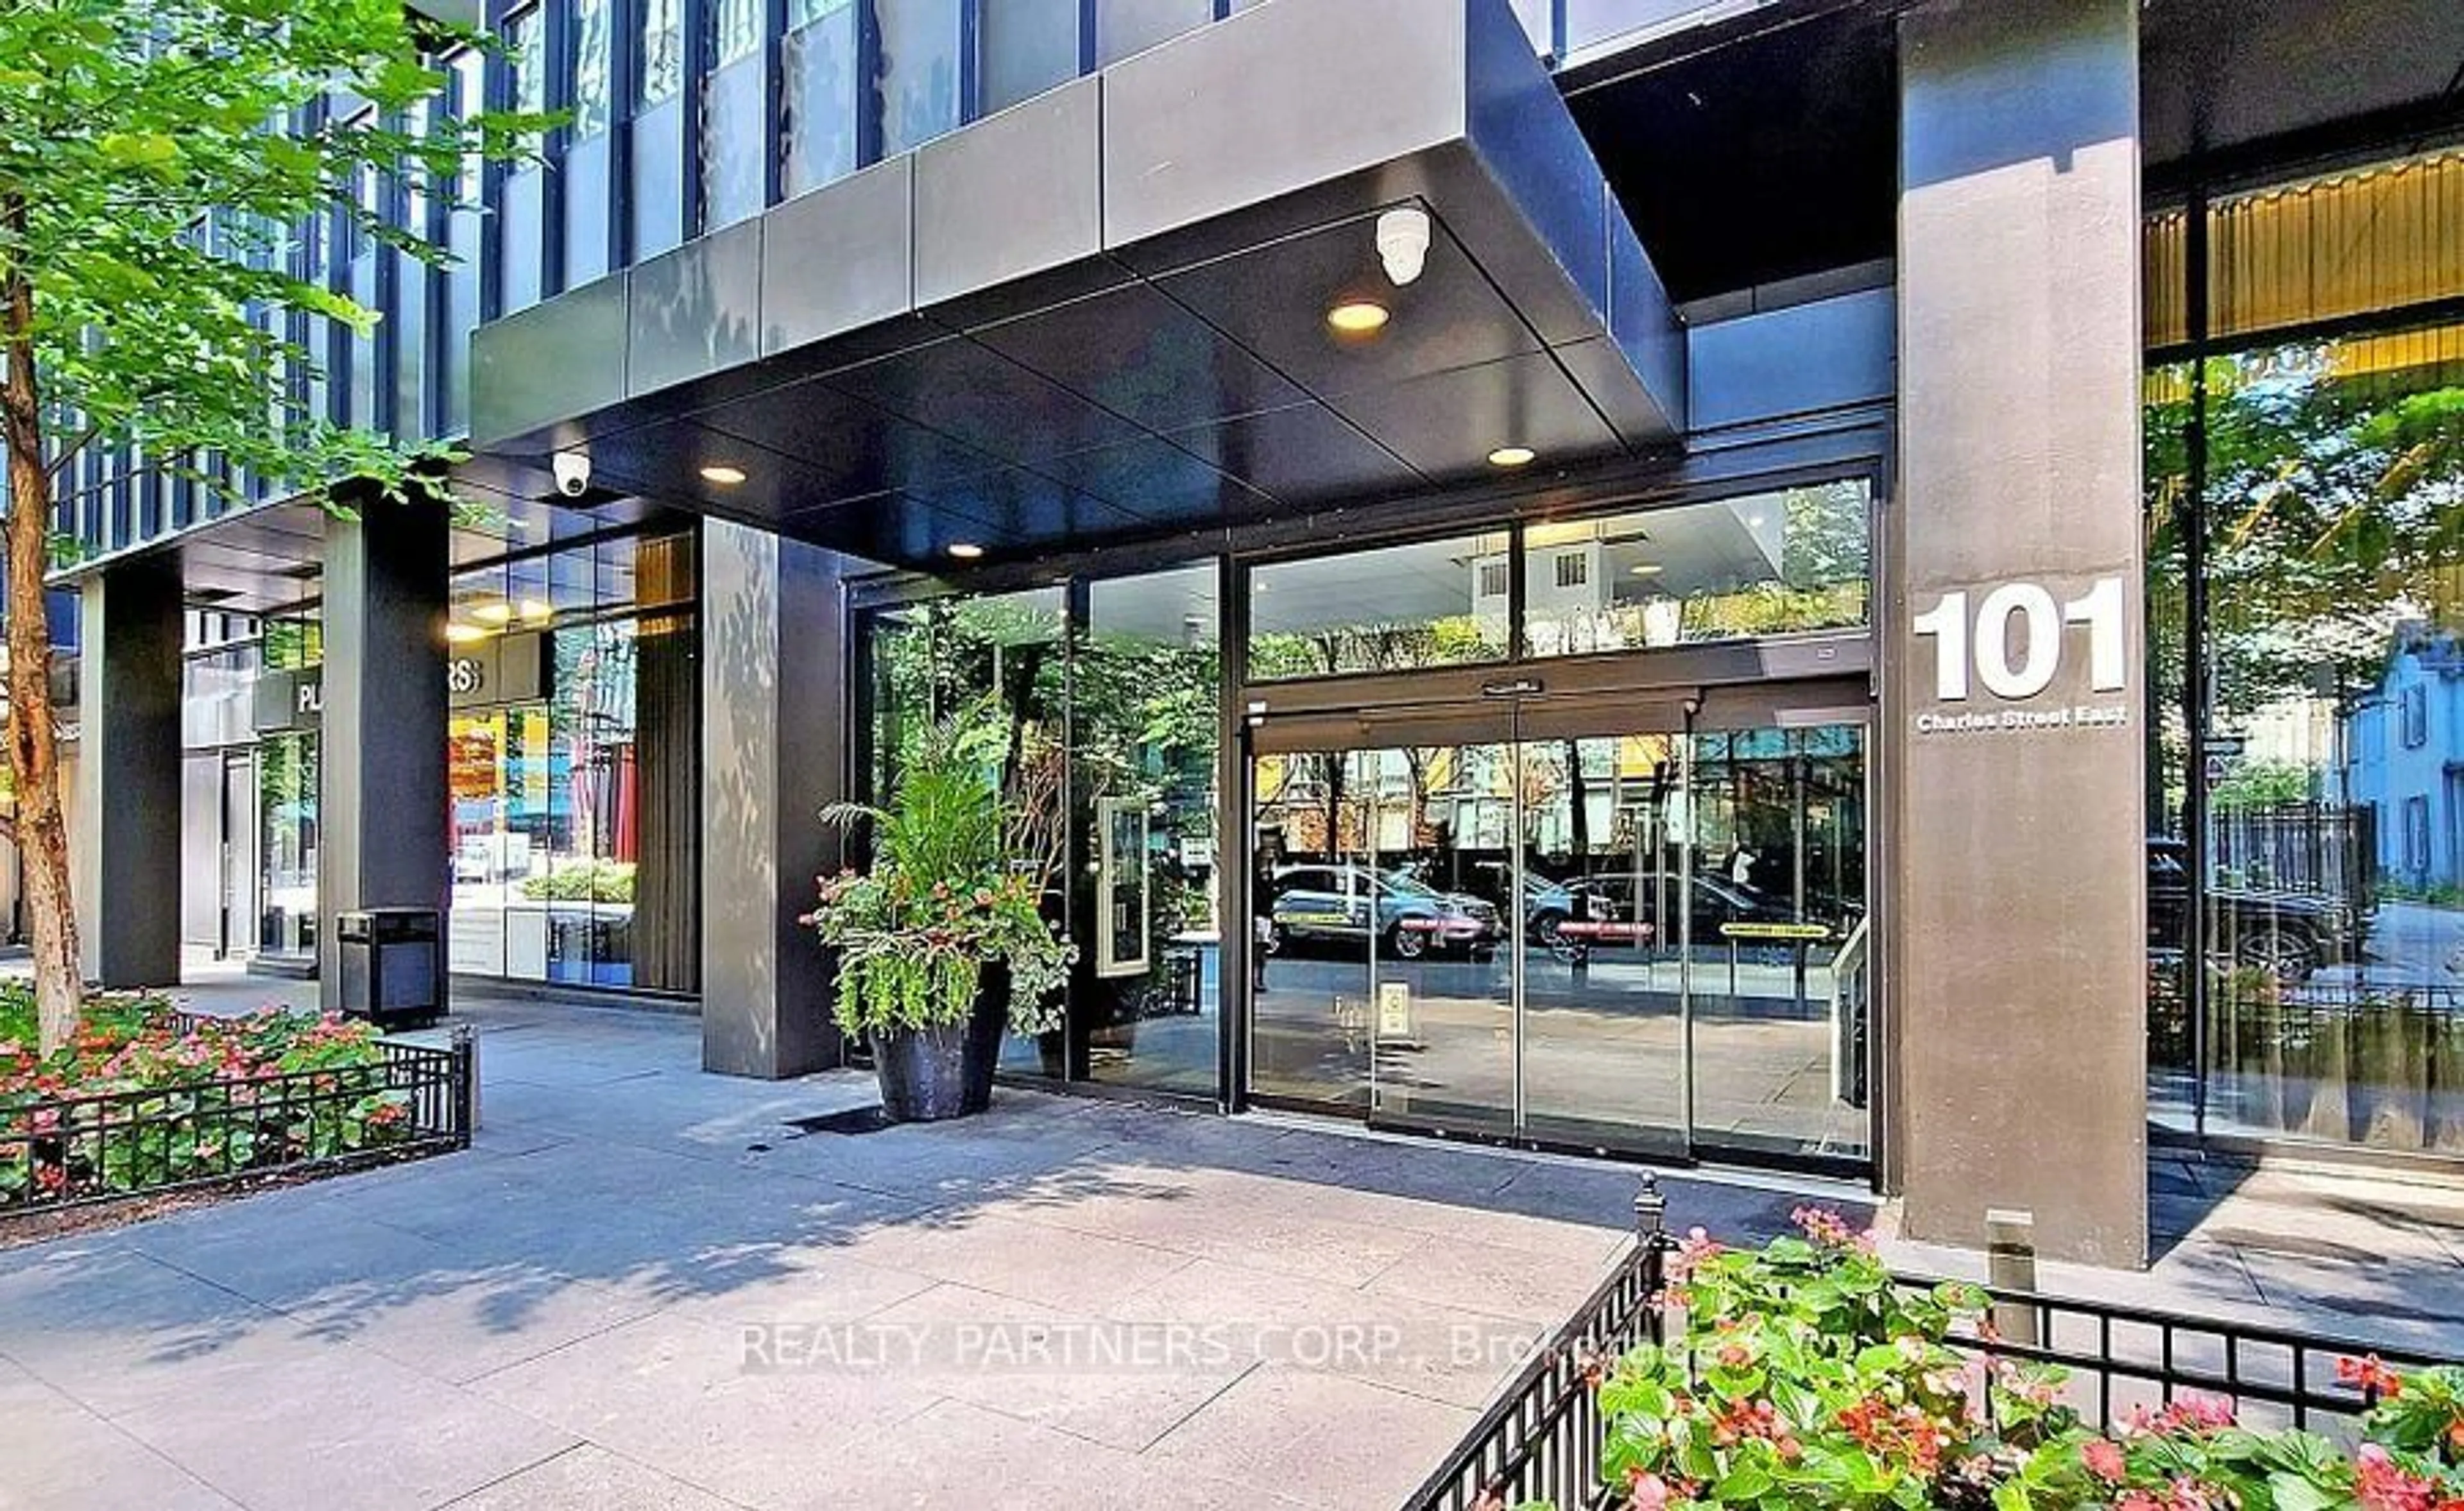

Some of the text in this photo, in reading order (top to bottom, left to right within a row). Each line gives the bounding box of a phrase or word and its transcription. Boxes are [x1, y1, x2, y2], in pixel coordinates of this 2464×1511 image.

[1913, 577, 2126, 699] 101
[1917, 704, 2126, 732] Charles Street East
